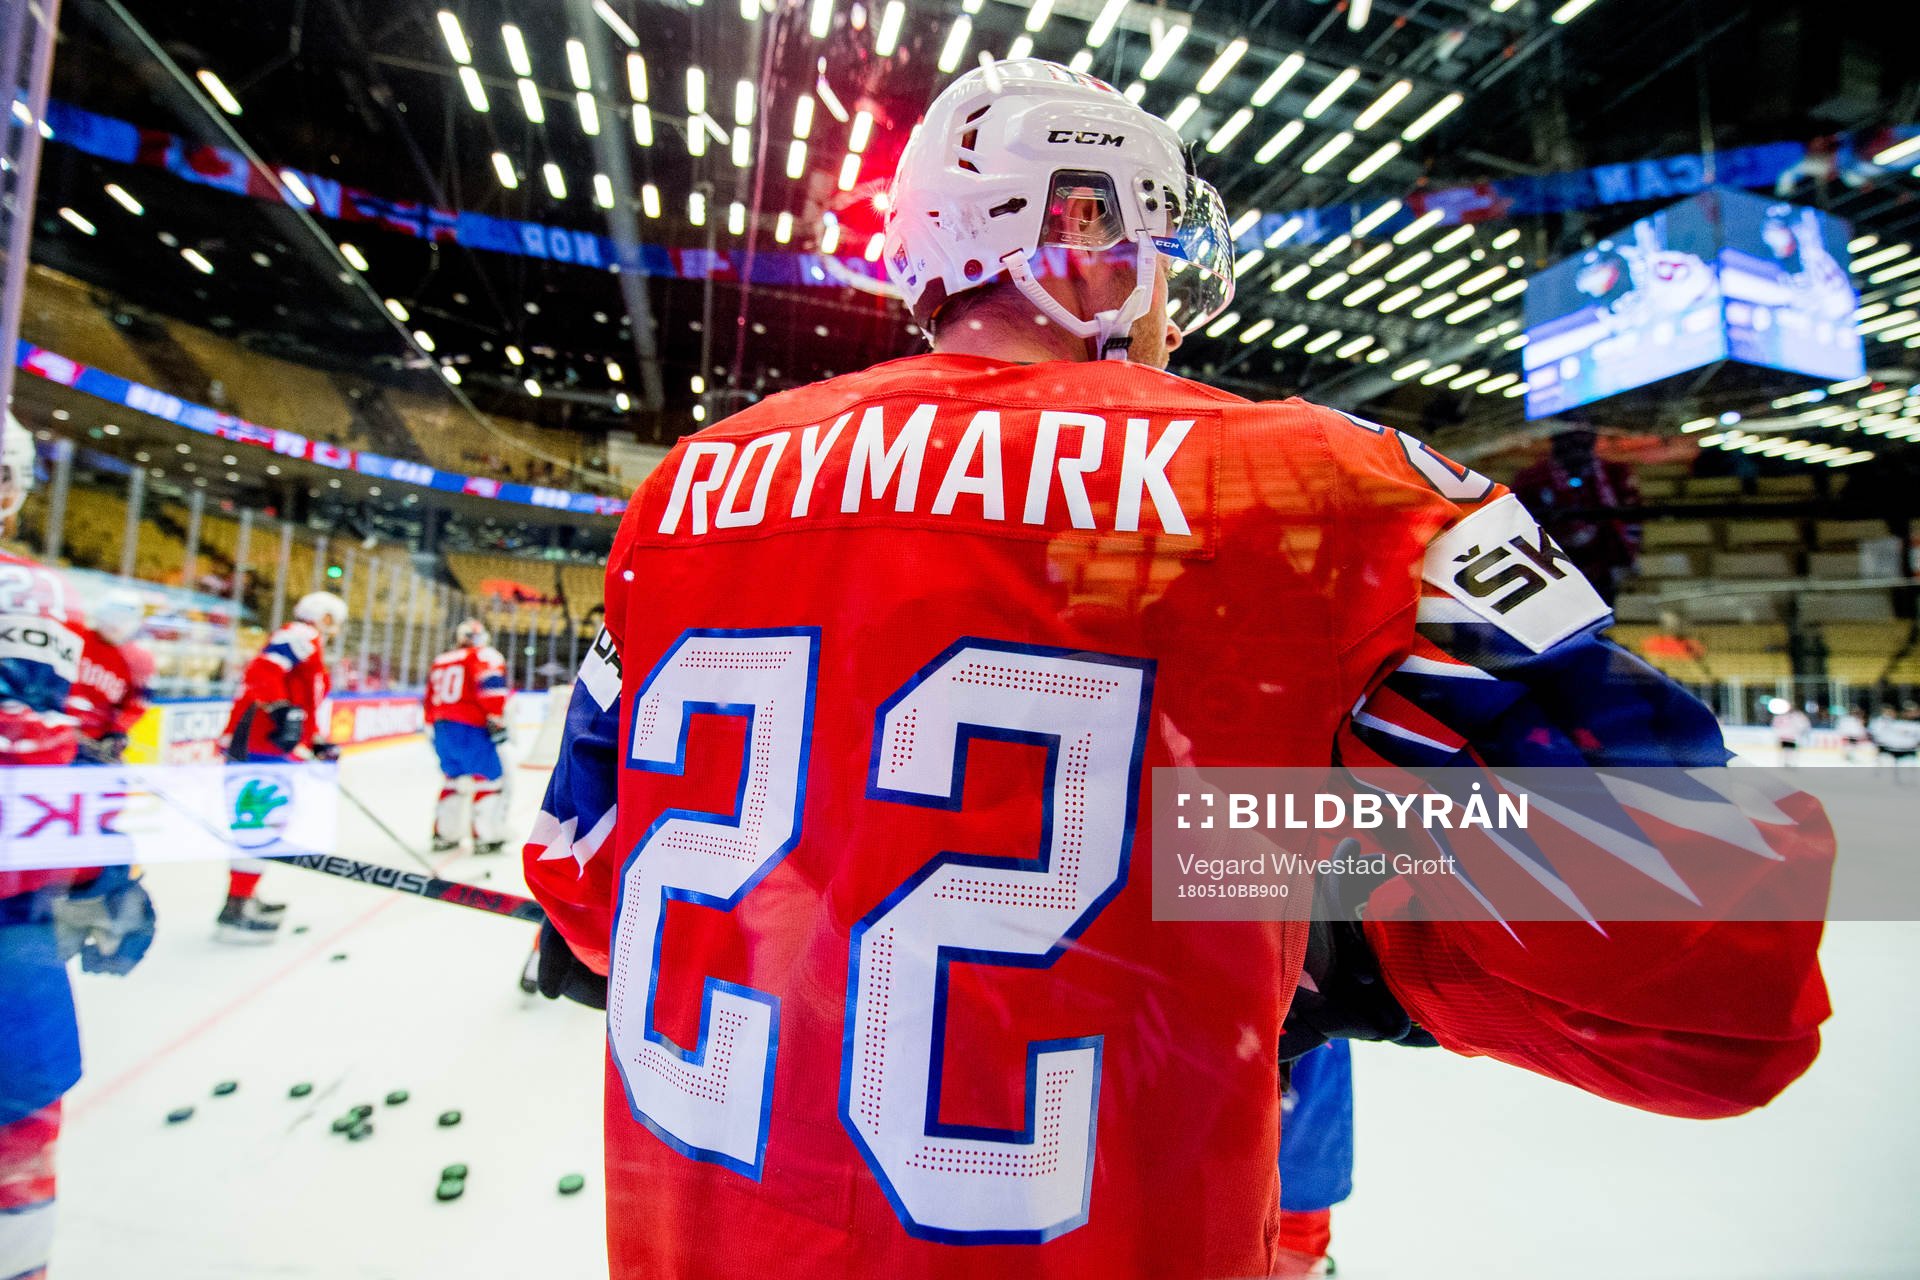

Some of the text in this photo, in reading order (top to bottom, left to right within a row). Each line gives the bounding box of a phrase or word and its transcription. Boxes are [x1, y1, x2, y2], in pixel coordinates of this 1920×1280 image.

[1047, 130, 1125, 148] CCM
[1154, 239, 1180, 250] CCM
[657, 403, 1196, 536] ROYMARK
[296, 853, 429, 896] NEXUS
[606, 626, 1158, 1247] 22
